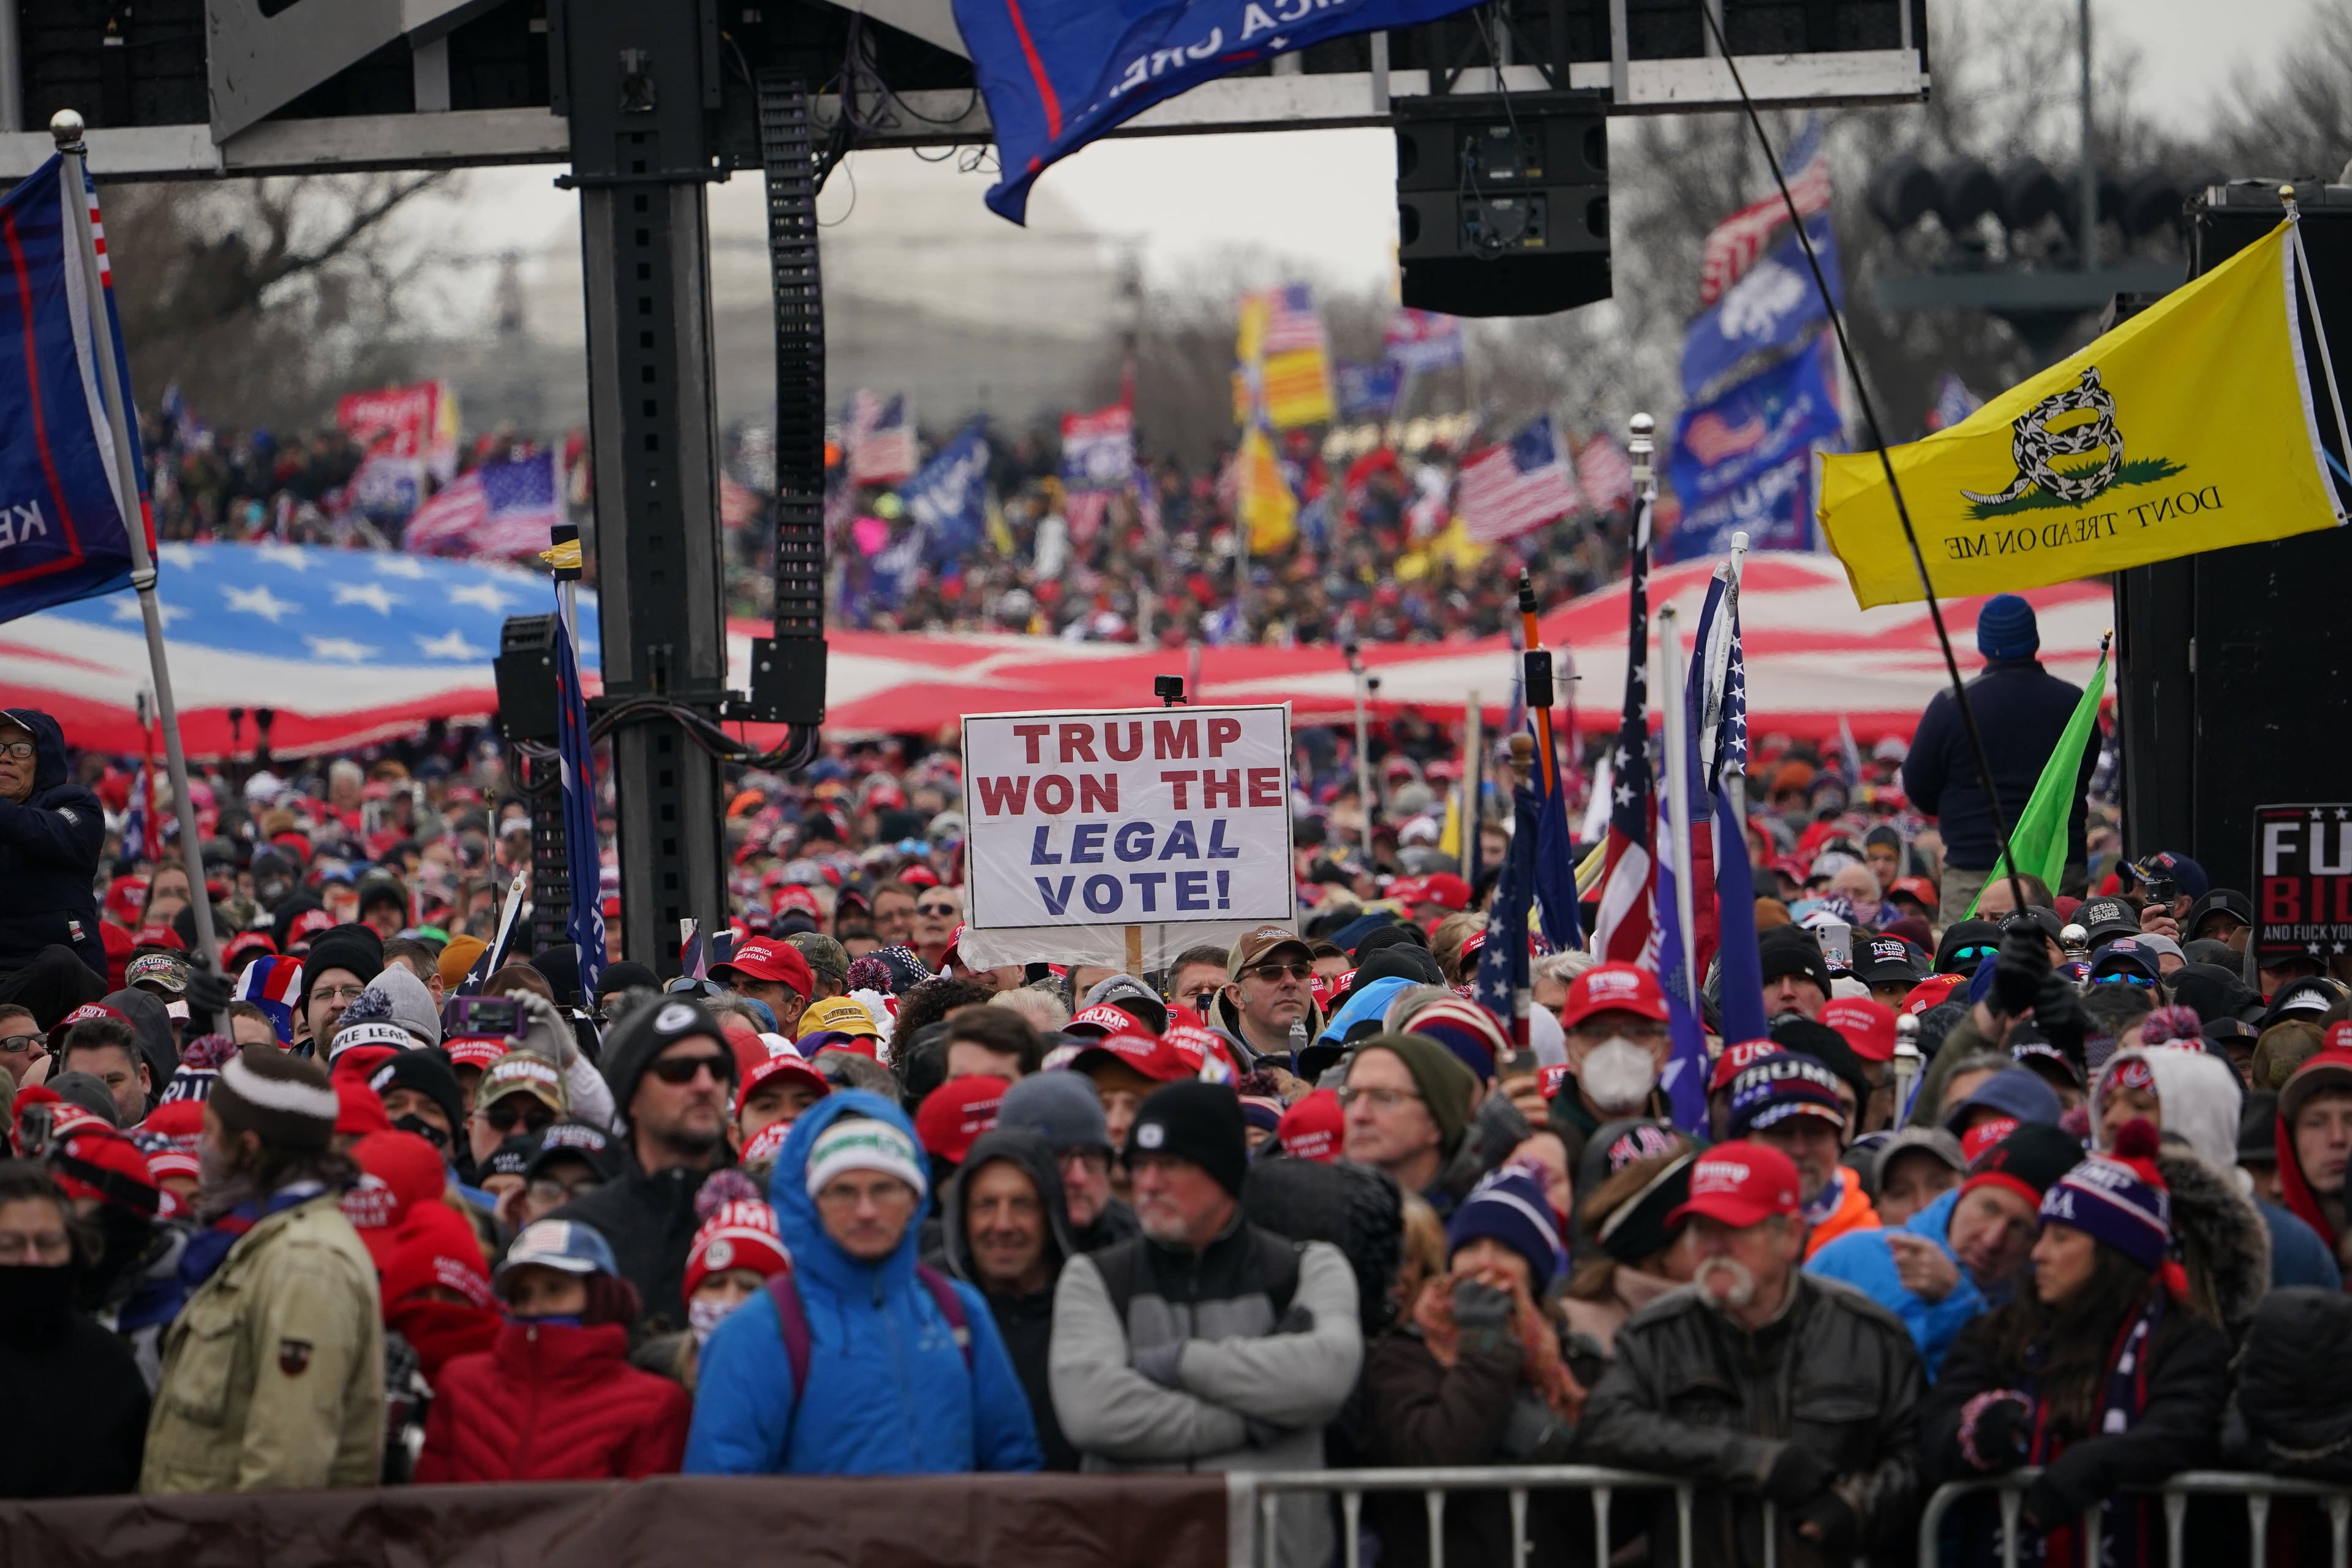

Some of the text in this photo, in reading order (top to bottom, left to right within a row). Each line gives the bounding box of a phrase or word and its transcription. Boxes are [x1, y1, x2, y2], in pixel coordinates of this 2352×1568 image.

[1013, 717, 1242, 764] TRUMP
[976, 767, 1283, 816] WON THE
[1030, 819, 1240, 865] LEGAL
[1034, 870, 1231, 916] VOTE!
[2089, 902, 2117, 914] JESUS
[2089, 911, 2120, 922] TRUMP
[2263, 925, 2291, 941] AND
[2294, 924, 2328, 941] FUCK
[745, 946, 772, 957] AMERICA
[1870, 942, 1905, 954] Trump
[135, 957, 172, 968] Trump
[745, 953, 767, 962] AGAIN
[1077, 1008, 1129, 1030] TRUMP
[492, 1060, 559, 1082] TRUMP
